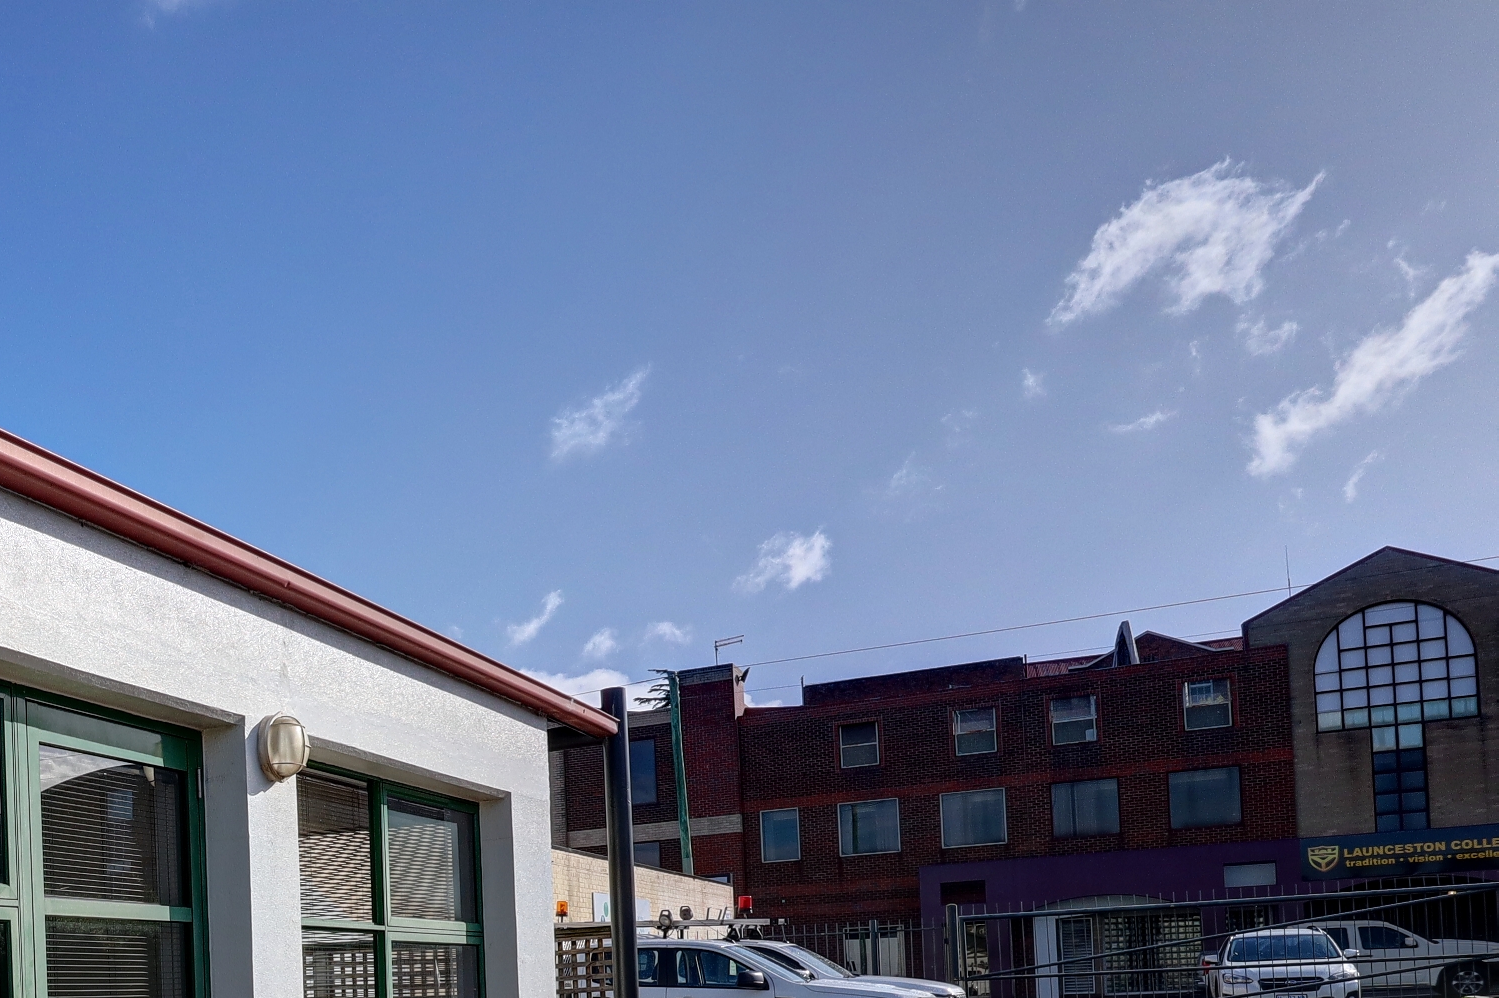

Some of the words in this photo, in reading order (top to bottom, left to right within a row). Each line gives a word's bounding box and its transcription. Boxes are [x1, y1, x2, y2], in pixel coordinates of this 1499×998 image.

[1344, 842, 1446, 858] LAUNCESTON
[1346, 857, 1395, 868] tradition
[1407, 854, 1444, 863] vision
